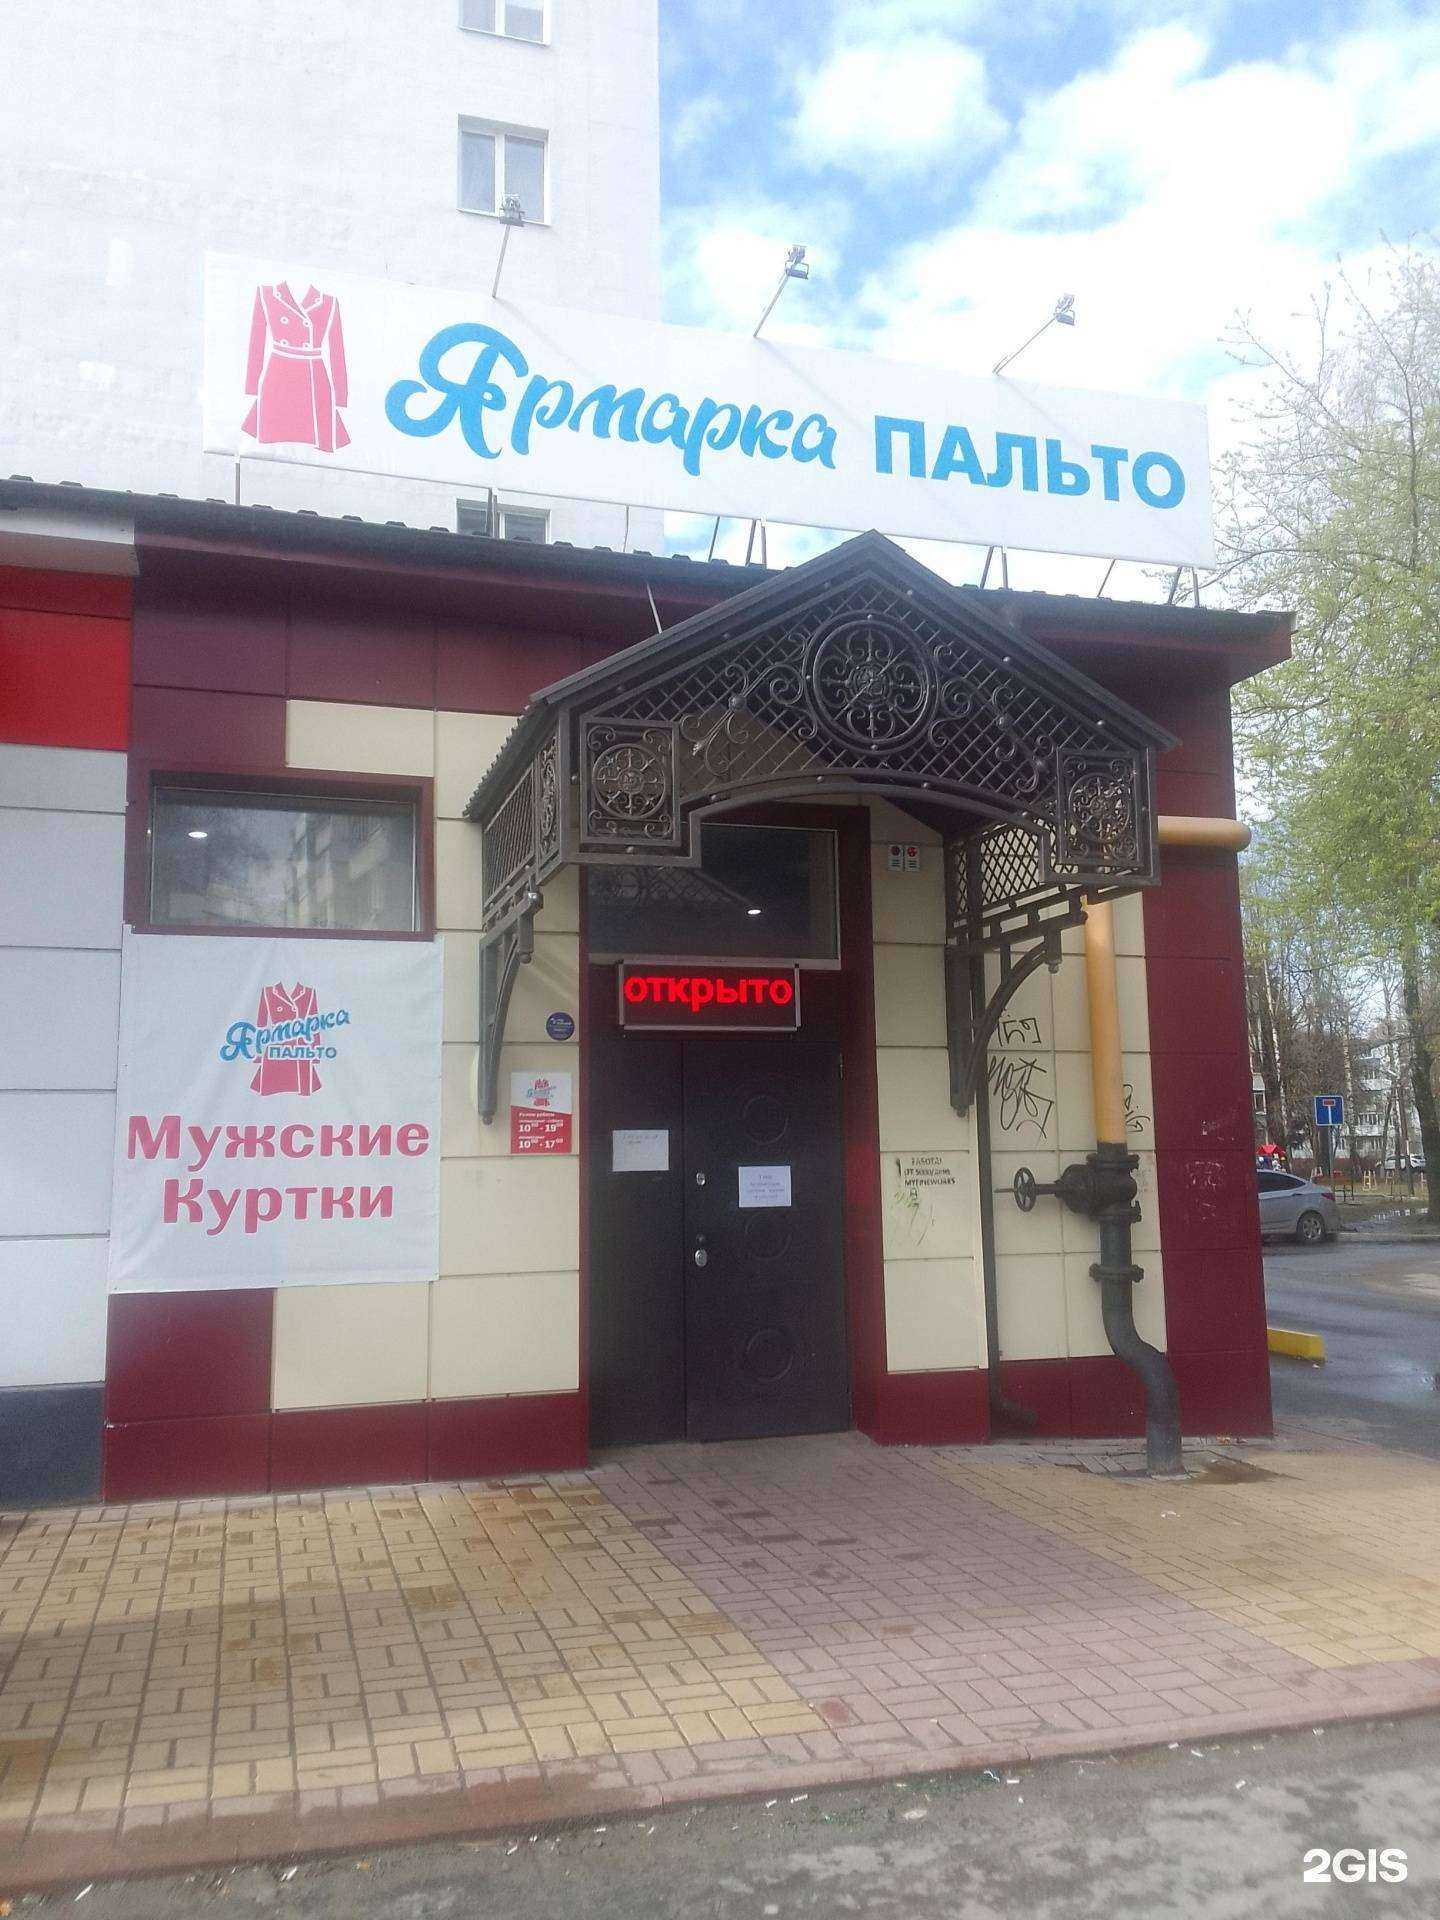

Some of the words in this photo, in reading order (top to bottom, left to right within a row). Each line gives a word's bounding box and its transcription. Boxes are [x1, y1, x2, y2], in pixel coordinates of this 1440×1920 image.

[386, 323, 836, 476] Ярмарка
[875, 416, 1186, 509] ПАЛЬТО
[624, 976, 793, 1013] открыто
[220, 1009, 350, 1061] Ярмарка
[269, 1046, 337, 1059] ПАЛЬТО
[128, 1115, 429, 1172] Мужские
[163, 1178, 393, 1235] Куртки
